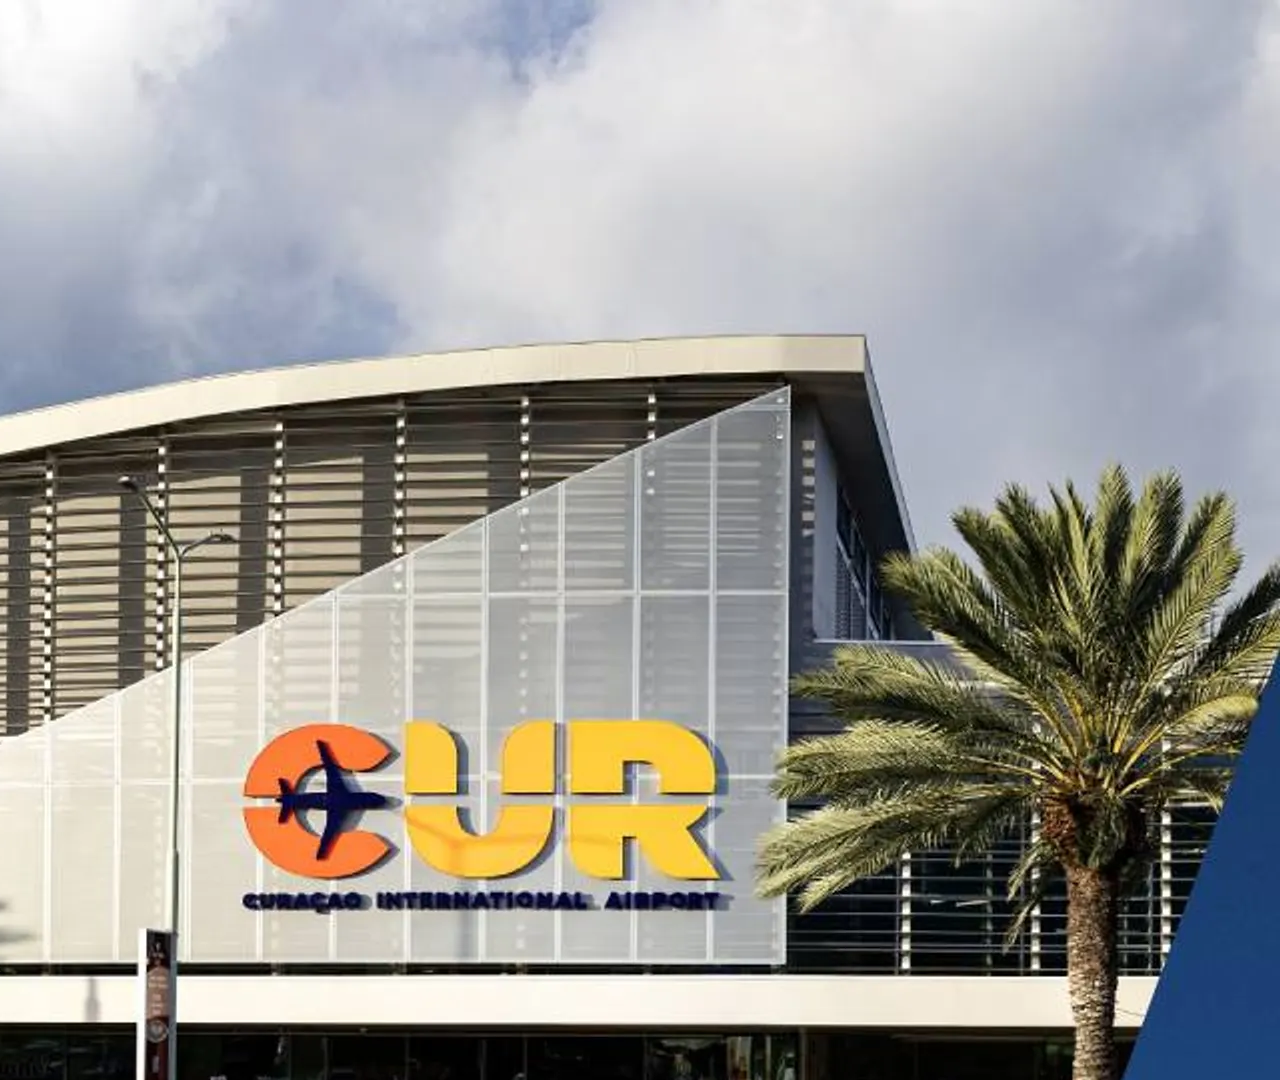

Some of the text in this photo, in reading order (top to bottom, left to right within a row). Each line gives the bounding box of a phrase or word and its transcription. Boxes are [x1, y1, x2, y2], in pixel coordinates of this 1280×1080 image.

[243, 719, 721, 880] CUR
[243, 892, 720, 914] CURAÇAO INTERNATIONAL AIRPORT
